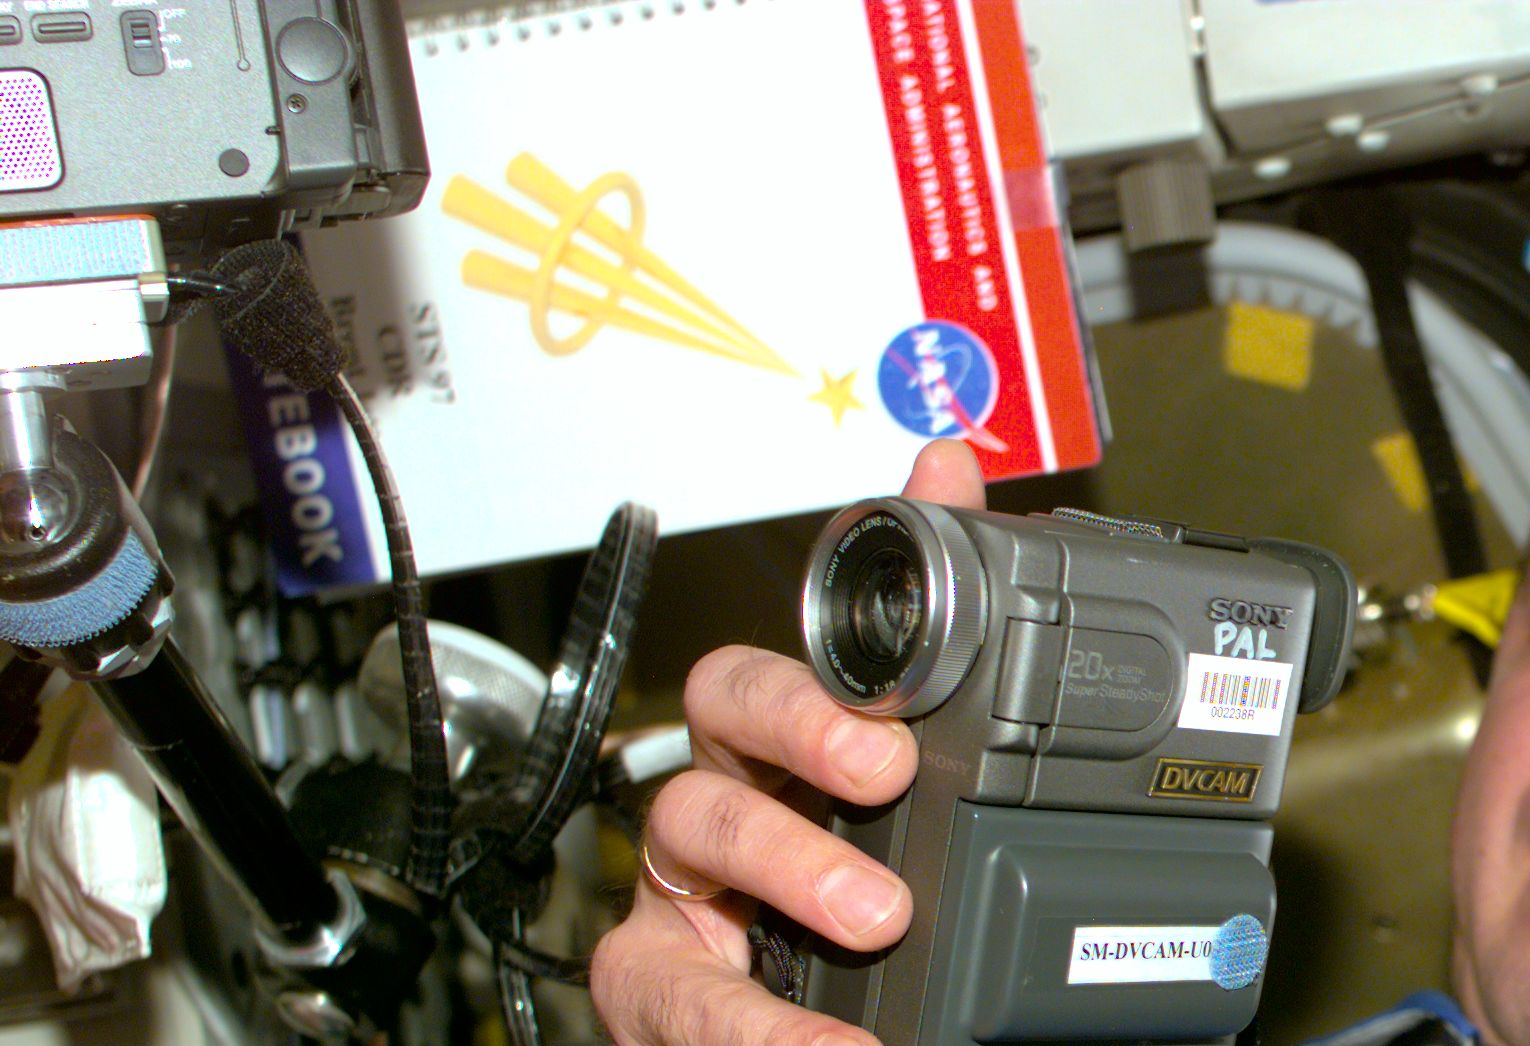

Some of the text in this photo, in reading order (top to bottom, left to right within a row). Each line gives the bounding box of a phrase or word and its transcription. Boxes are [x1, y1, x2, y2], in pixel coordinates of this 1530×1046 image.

[900, 75, 950, 262] ADMINISTRATION
[920, 0, 998, 312] ATIONAL AERONAUTICS AND
[910, 328, 957, 434] NASA
[1207, 597, 1294, 630] SONY
[1214, 621, 1277, 660] PAL
[1211, 706, 1255, 721] 002238R
[1160, 766, 1250, 795] DVCAM
